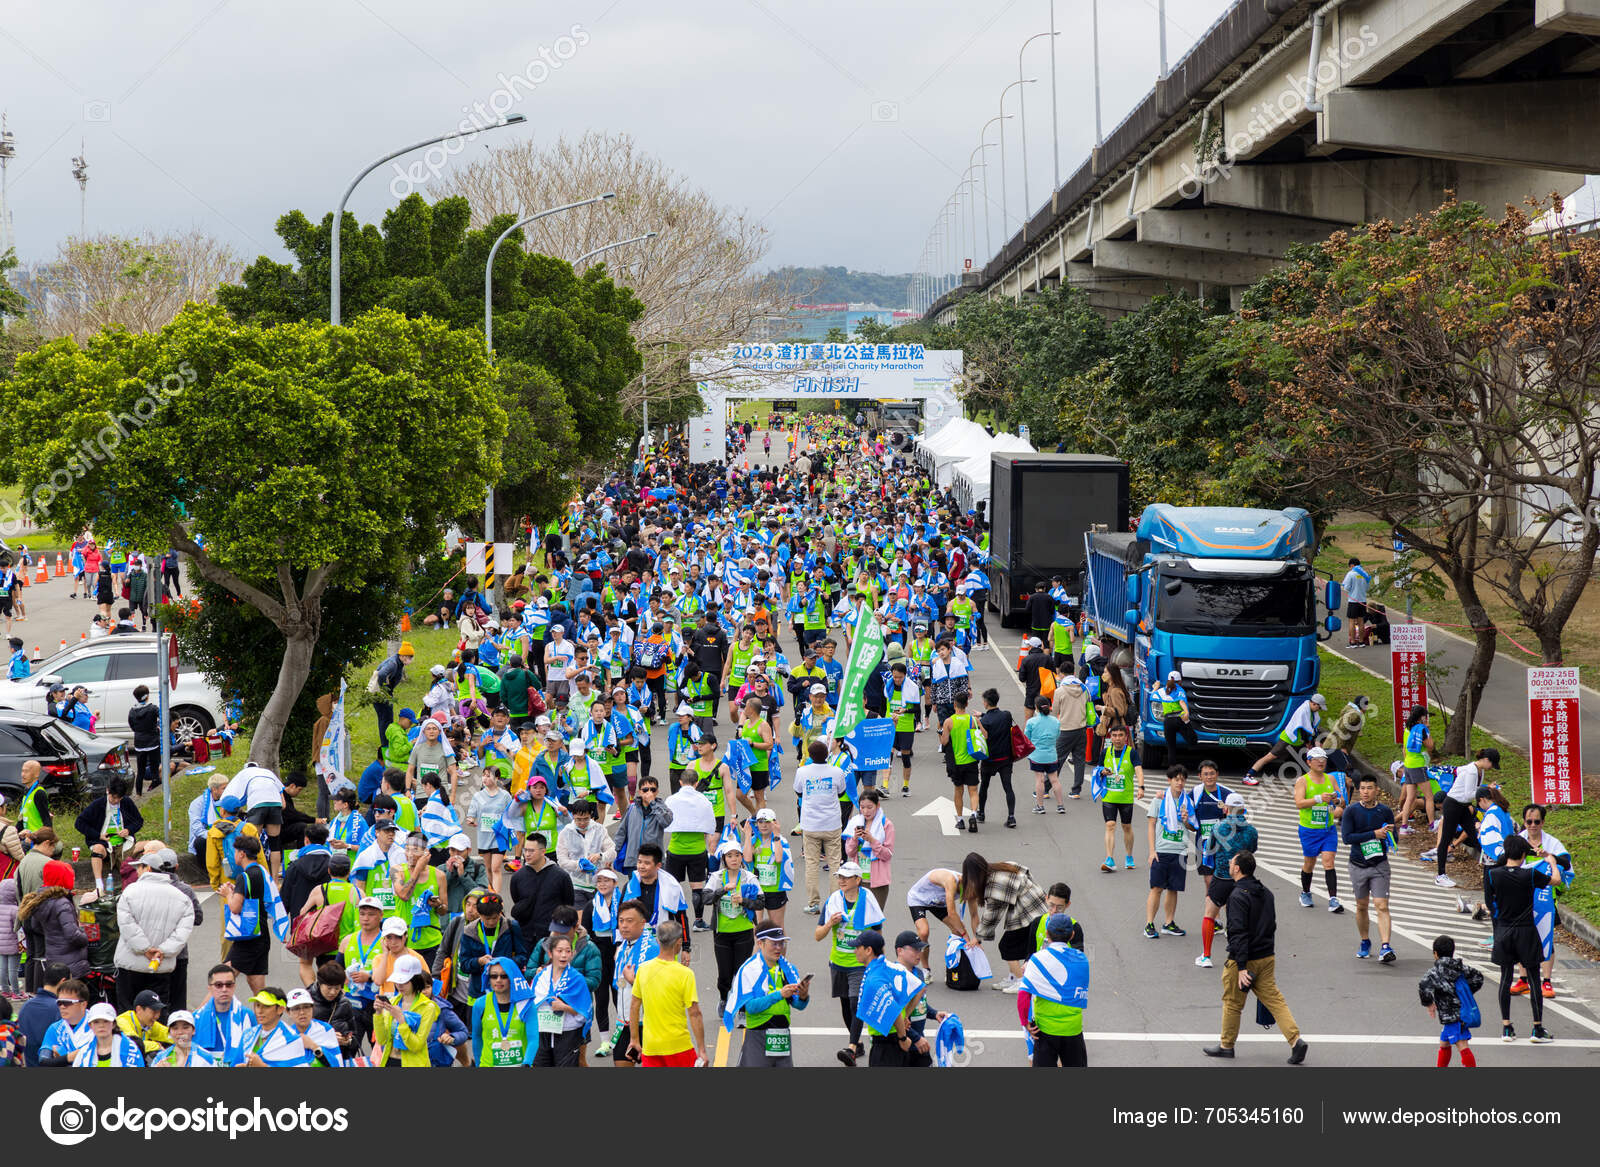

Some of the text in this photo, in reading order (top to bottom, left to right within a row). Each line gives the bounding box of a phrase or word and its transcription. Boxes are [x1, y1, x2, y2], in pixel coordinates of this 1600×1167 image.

[732, 344, 925, 360] 2024 渣打臺北公益馬拉松
[848, 362, 879, 371] Charity
[881, 362, 924, 370] Marathon
[793, 376, 860, 393] FINISH
[1216, 668, 1254, 677] DAF
[1532, 670, 1575, 678] 2月22-25日
[1541, 699, 1556, 803] 禁止停放加強拖吊
[1556, 699, 1571, 803] 本路段停車格位取消
[494, 1048, 521, 1060] 13285
